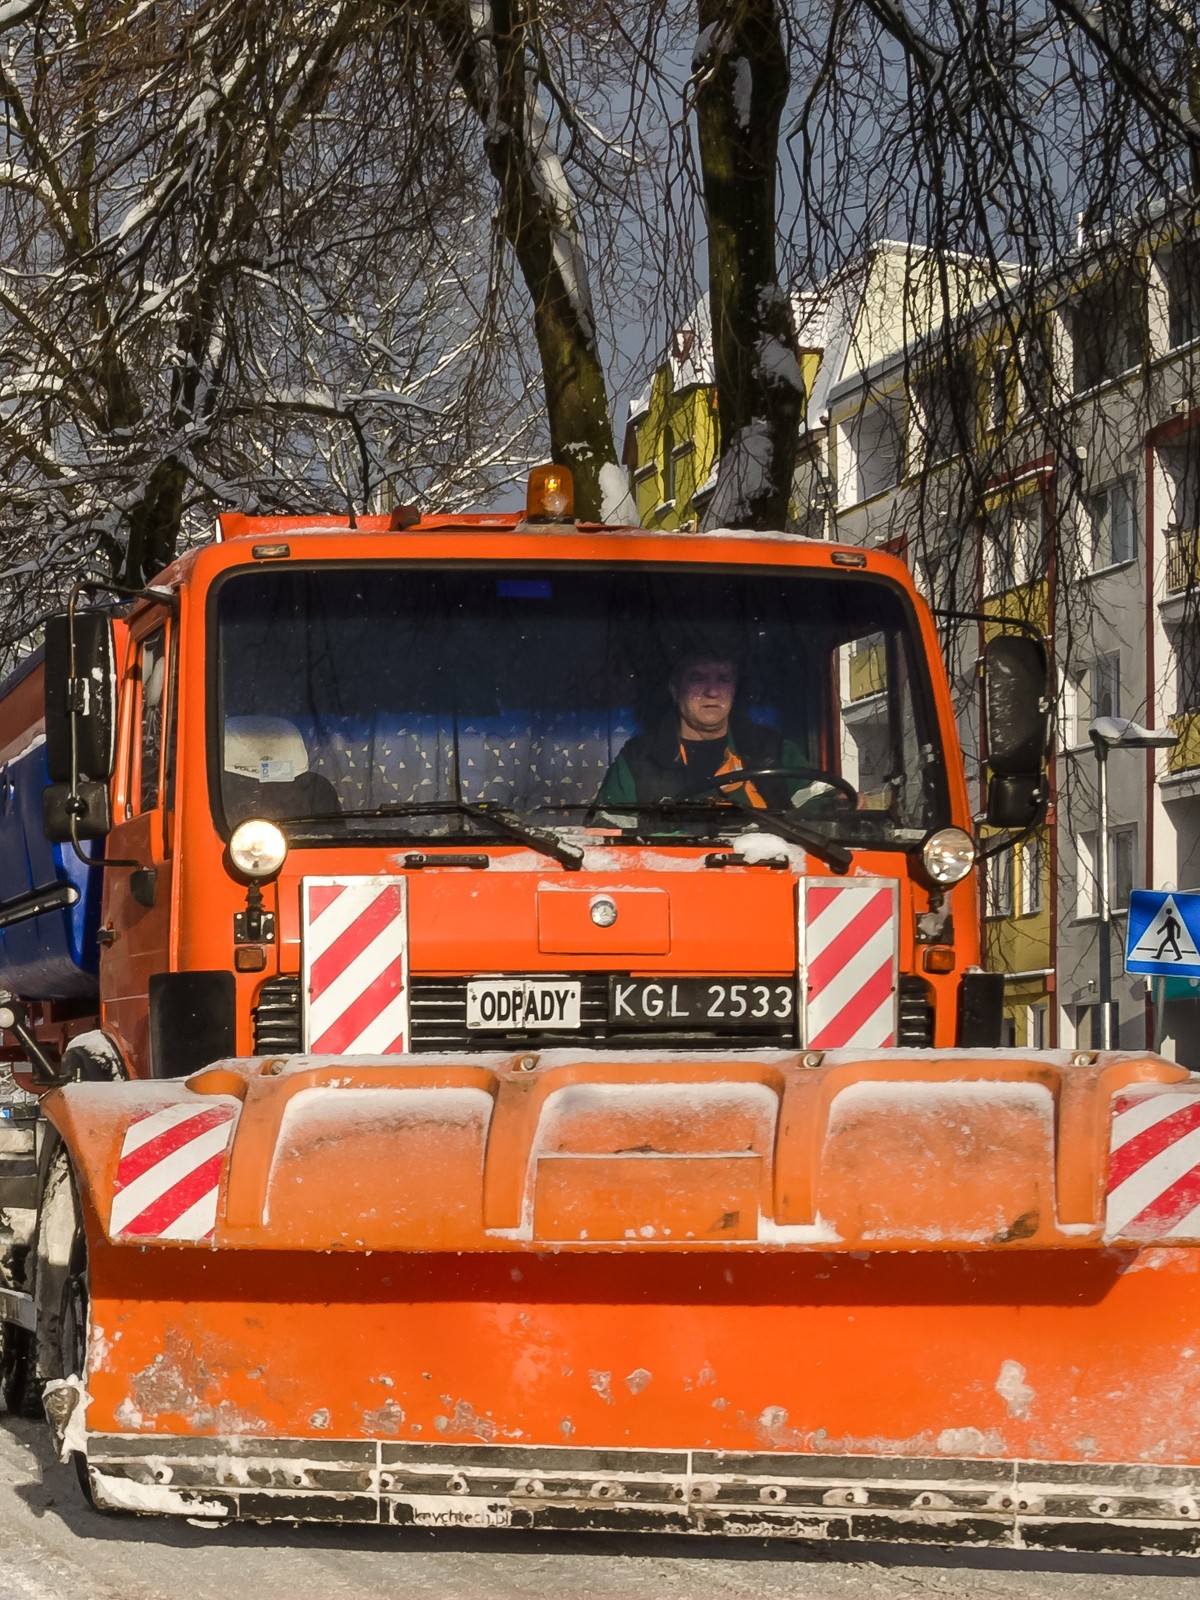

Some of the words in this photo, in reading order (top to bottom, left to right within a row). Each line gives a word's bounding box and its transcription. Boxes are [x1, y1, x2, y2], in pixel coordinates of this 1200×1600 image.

[480, 990, 570, 1022] ODPADY
[615, 984, 690, 1018] KGL
[706, 985, 793, 1018] 2533
